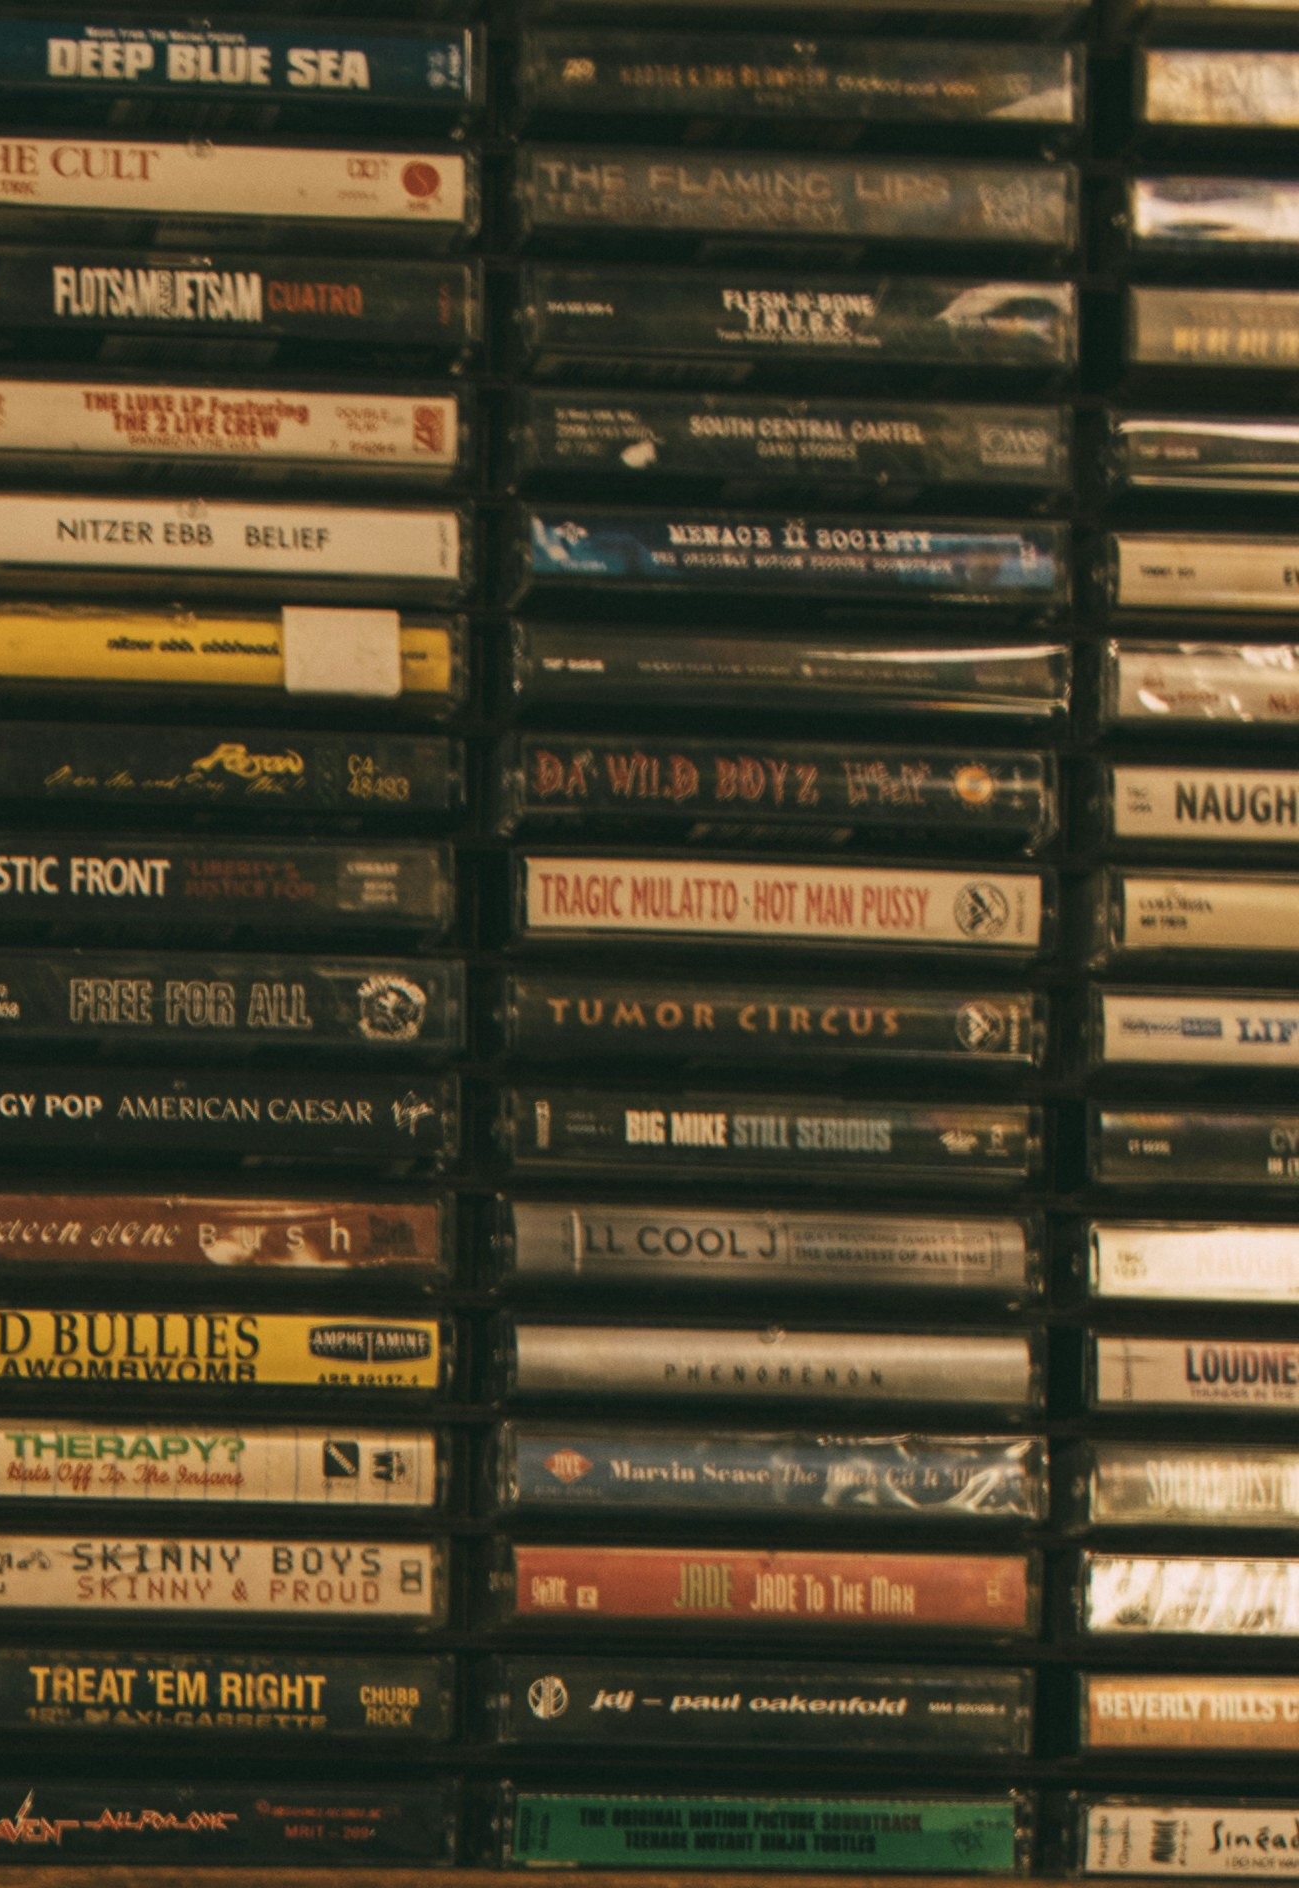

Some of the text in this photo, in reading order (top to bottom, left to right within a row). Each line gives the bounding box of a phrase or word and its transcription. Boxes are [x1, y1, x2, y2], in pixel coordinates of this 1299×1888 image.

[47, 39, 371, 89] DEEP BLUE SEA
[57, 519, 331, 550] NITZER EBB BELIEF
[45, 1096, 102, 1119] POP
[118, 1097, 260, 1121] AMERICAN
[268, 1099, 373, 1123] CAESAR
[29, 1666, 326, 1711] TREAT 'EM RIGHT
